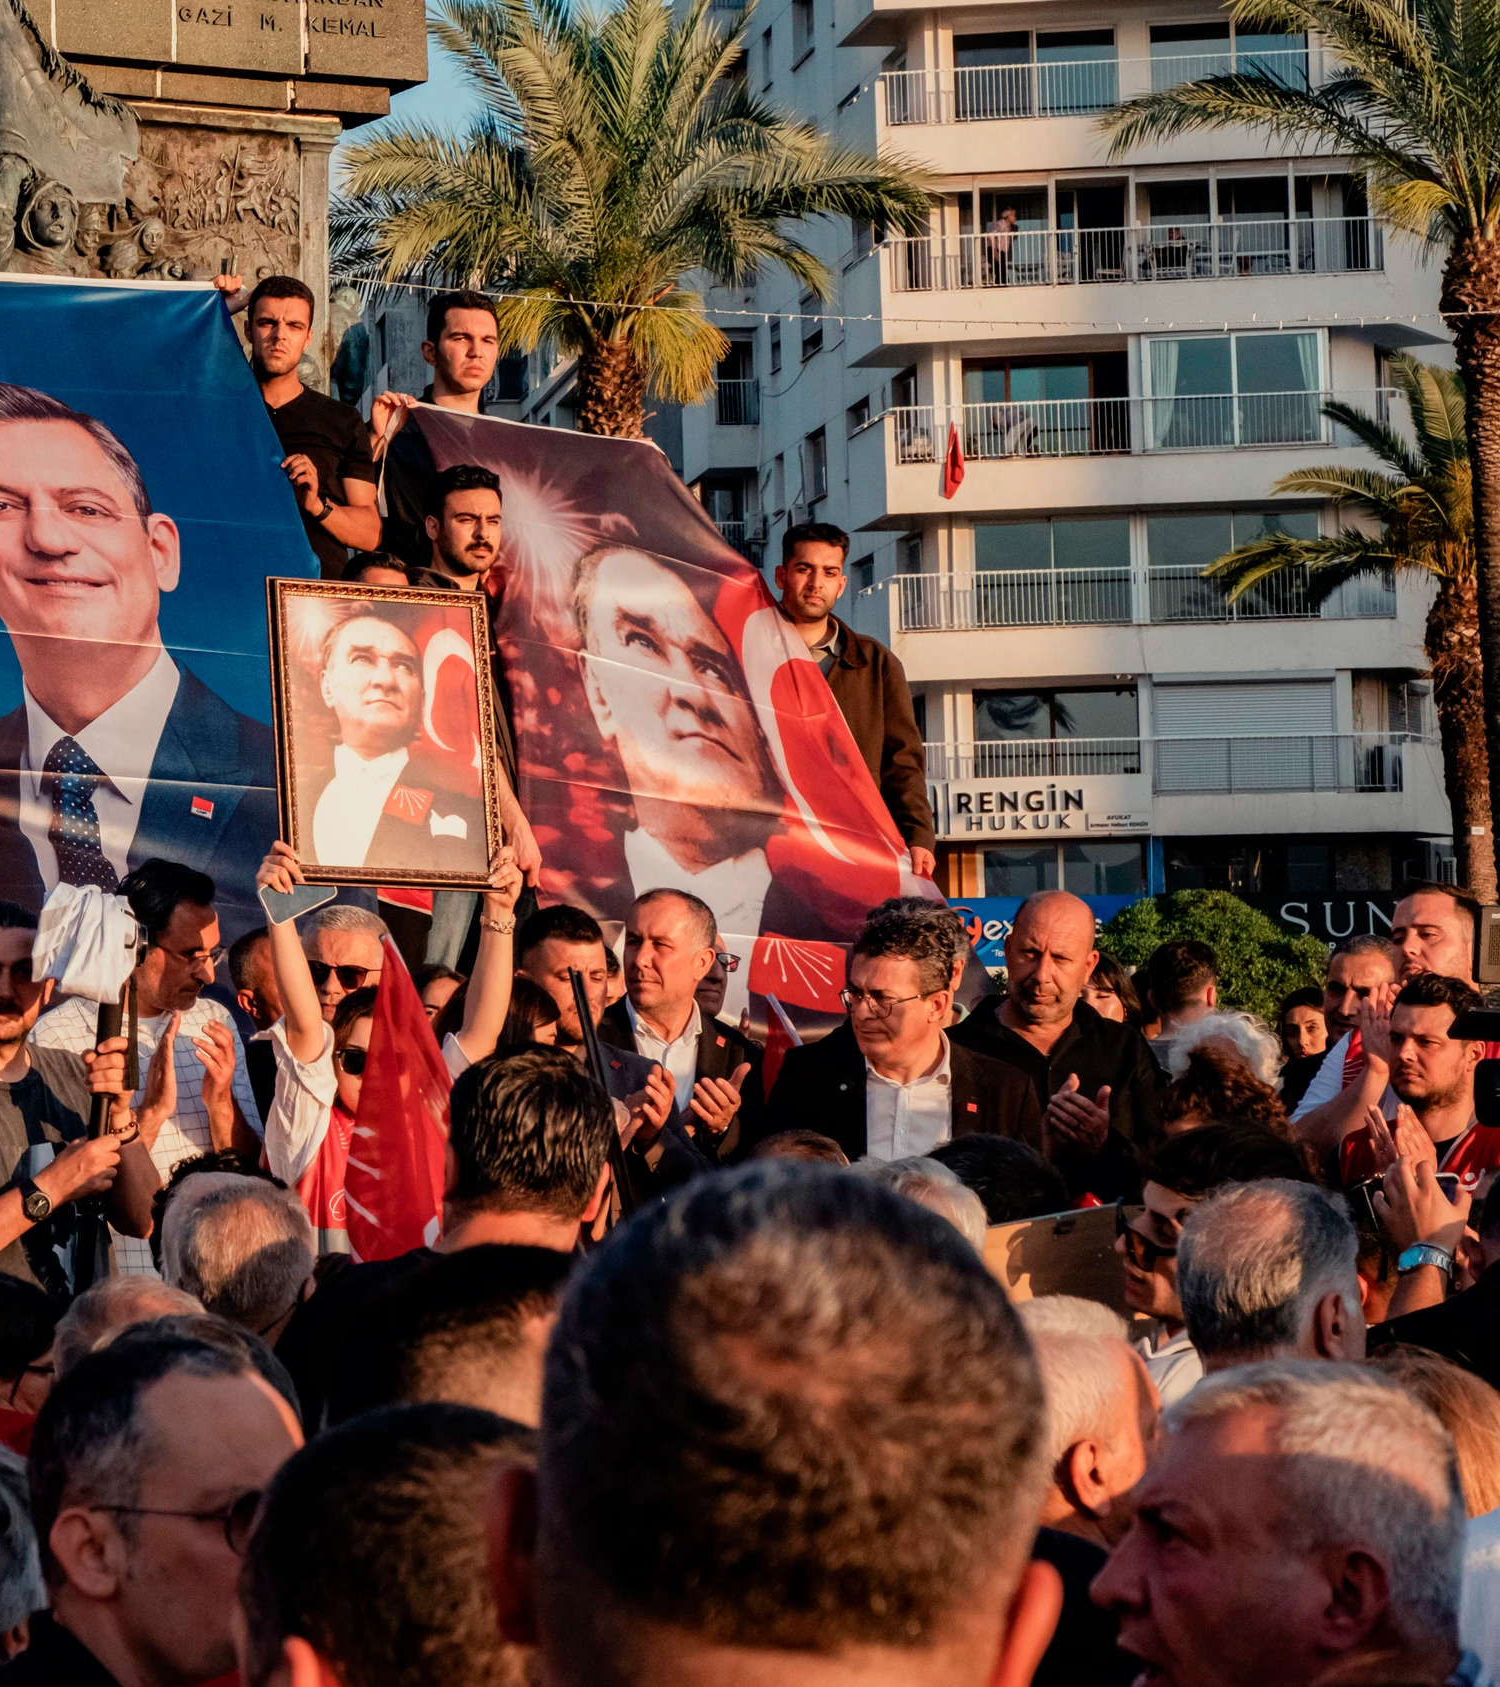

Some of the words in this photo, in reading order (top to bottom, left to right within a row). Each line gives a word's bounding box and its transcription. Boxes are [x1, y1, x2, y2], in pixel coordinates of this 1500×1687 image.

[178, 5, 232, 27] GAZİ
[260, 13, 283, 32] M.
[307, 16, 387, 39] KEMAL
[953, 782, 1084, 814] RENGİN
[965, 814, 1072, 832] HUKUK
